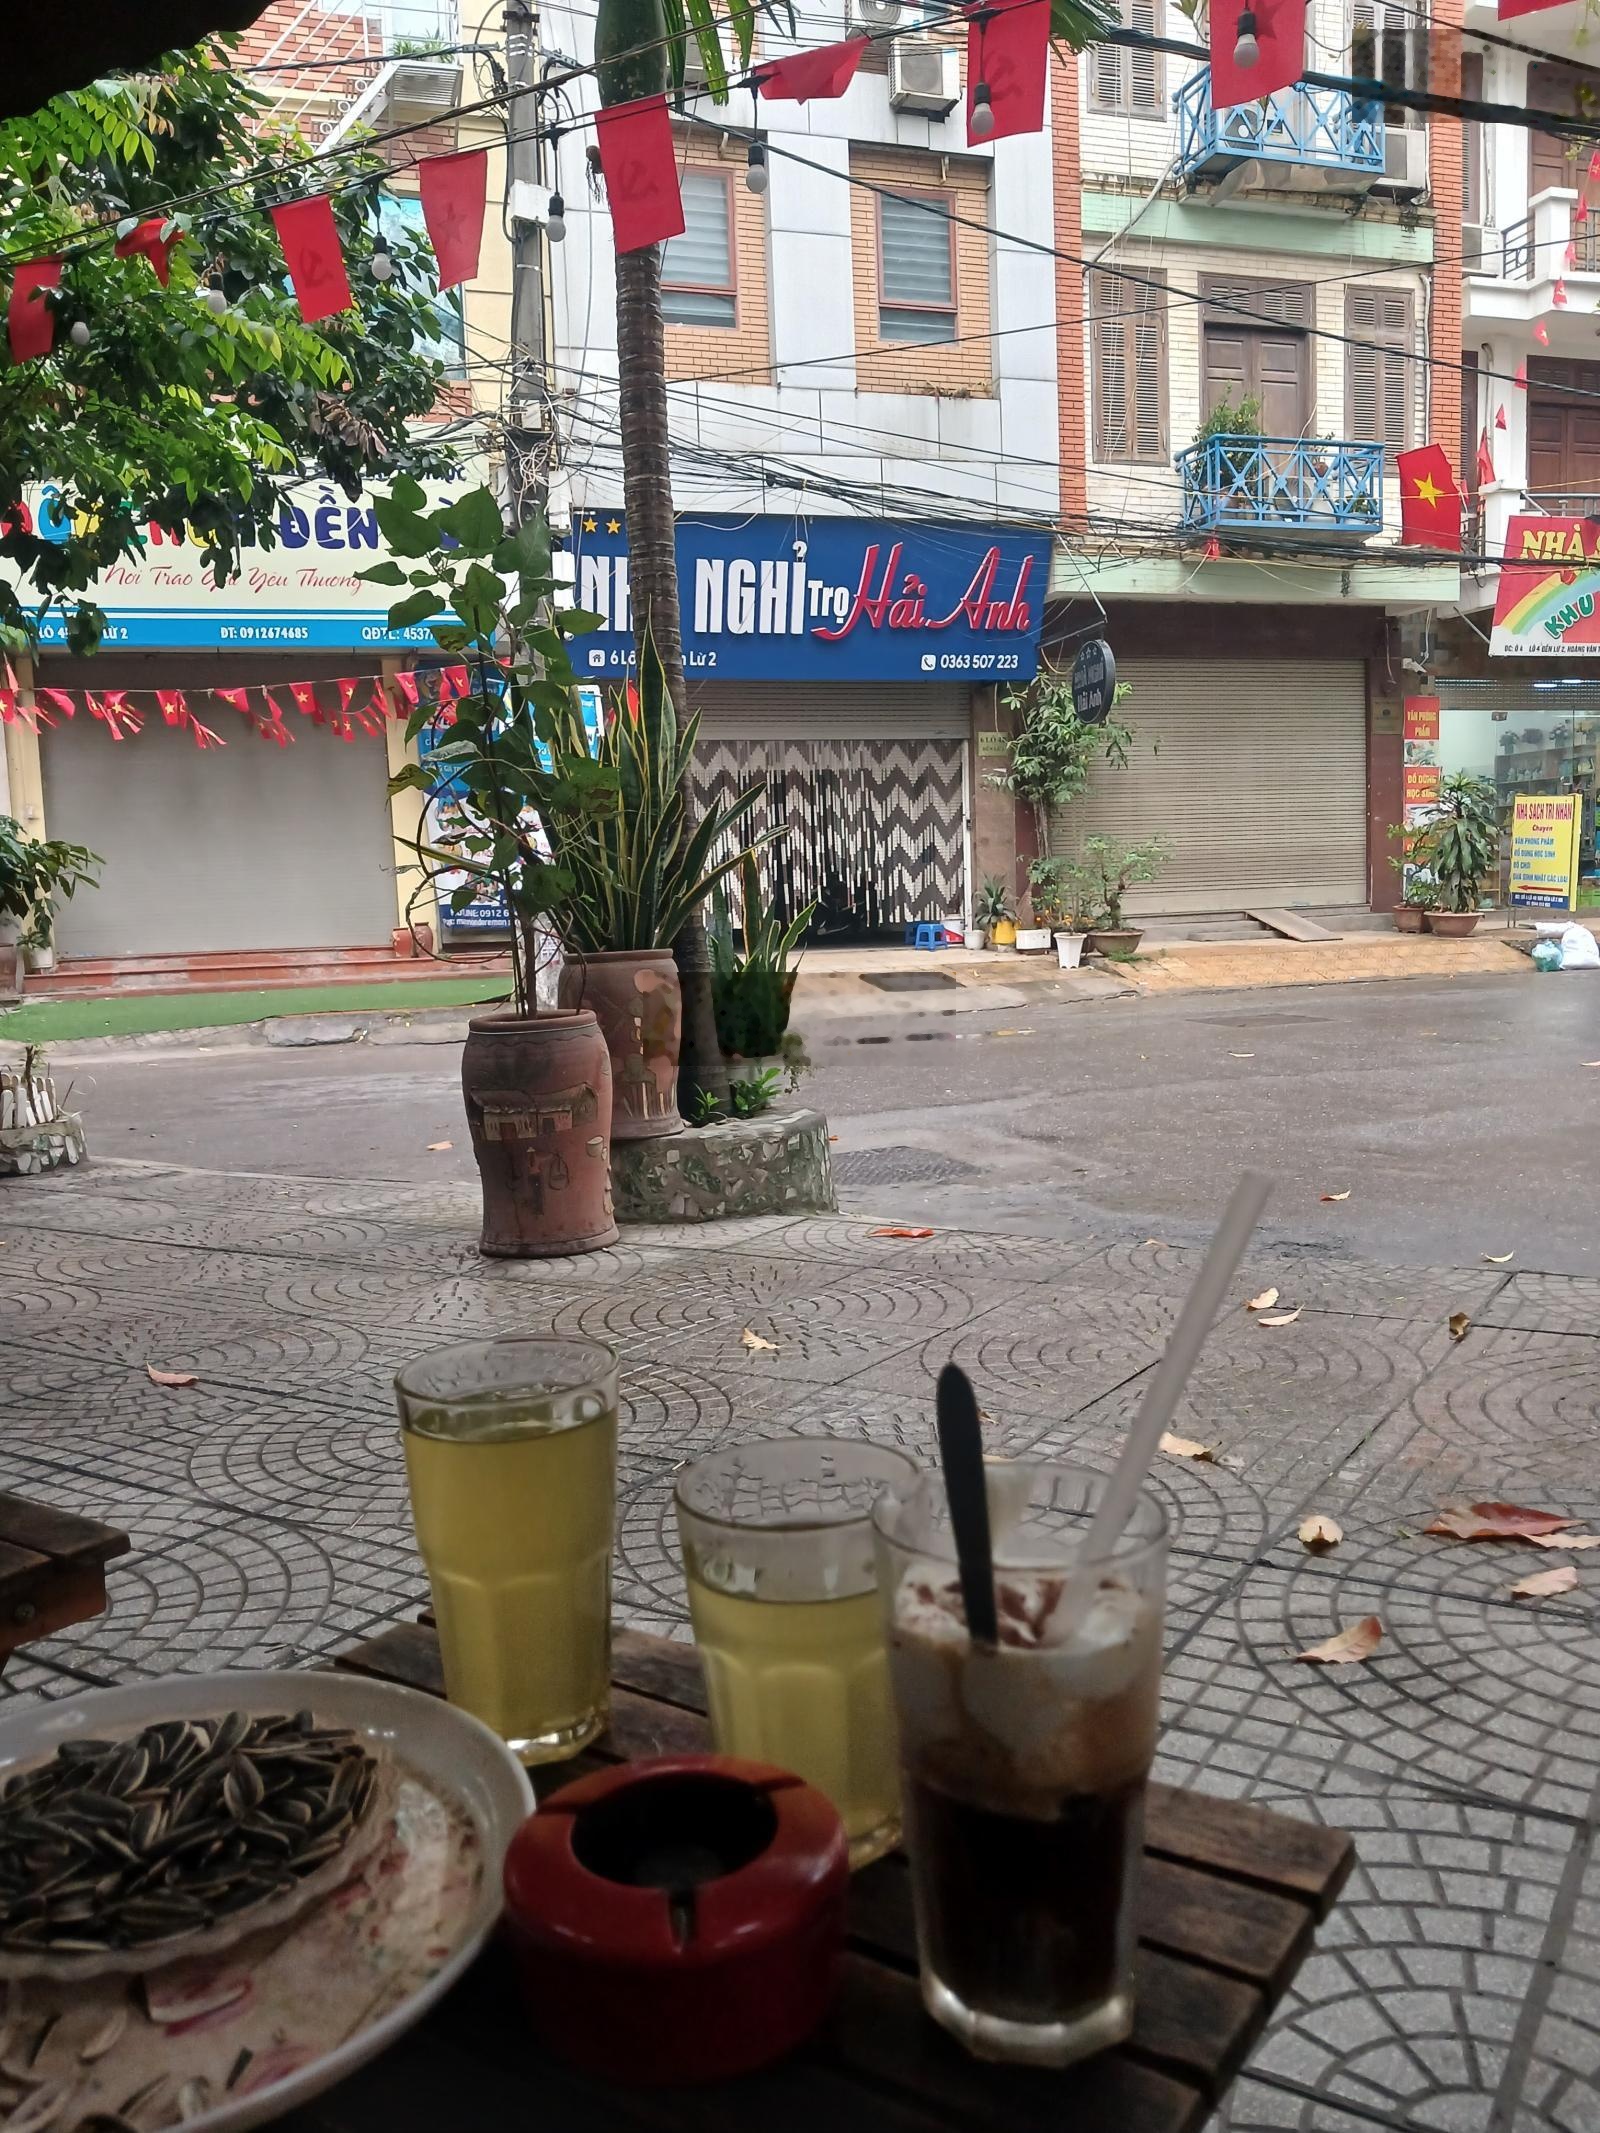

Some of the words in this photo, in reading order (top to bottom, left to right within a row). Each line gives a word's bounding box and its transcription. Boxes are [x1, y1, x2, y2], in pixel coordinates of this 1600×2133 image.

[279, 485, 379, 550] ĐỀN
[1519, 523, 1586, 561] NHÀ
[104, 565, 142, 585] Nơi
[150, 565, 193, 586] Trao
[581, 555, 634, 632] NH
[695, 540, 808, 635] NGHỈ
[811, 542, 928, 641] Hải
[925, 546, 1034, 632] Anh
[808, 580, 849, 624] Trọ
[1544, 593, 1595, 639] KHU
[120, 627, 129, 640] 2
[220, 627, 237, 639] ĐT:
[239, 627, 308, 640] 0912674685
[610, 650, 619, 665] 6
[689, 651, 707, 666] Lừ
[708, 652, 717, 666] 2
[940, 654, 970, 669] 0363
[972, 654, 996, 669] 507
[997, 654, 1019, 669] 223
[480, 909, 502, 918] 0912
